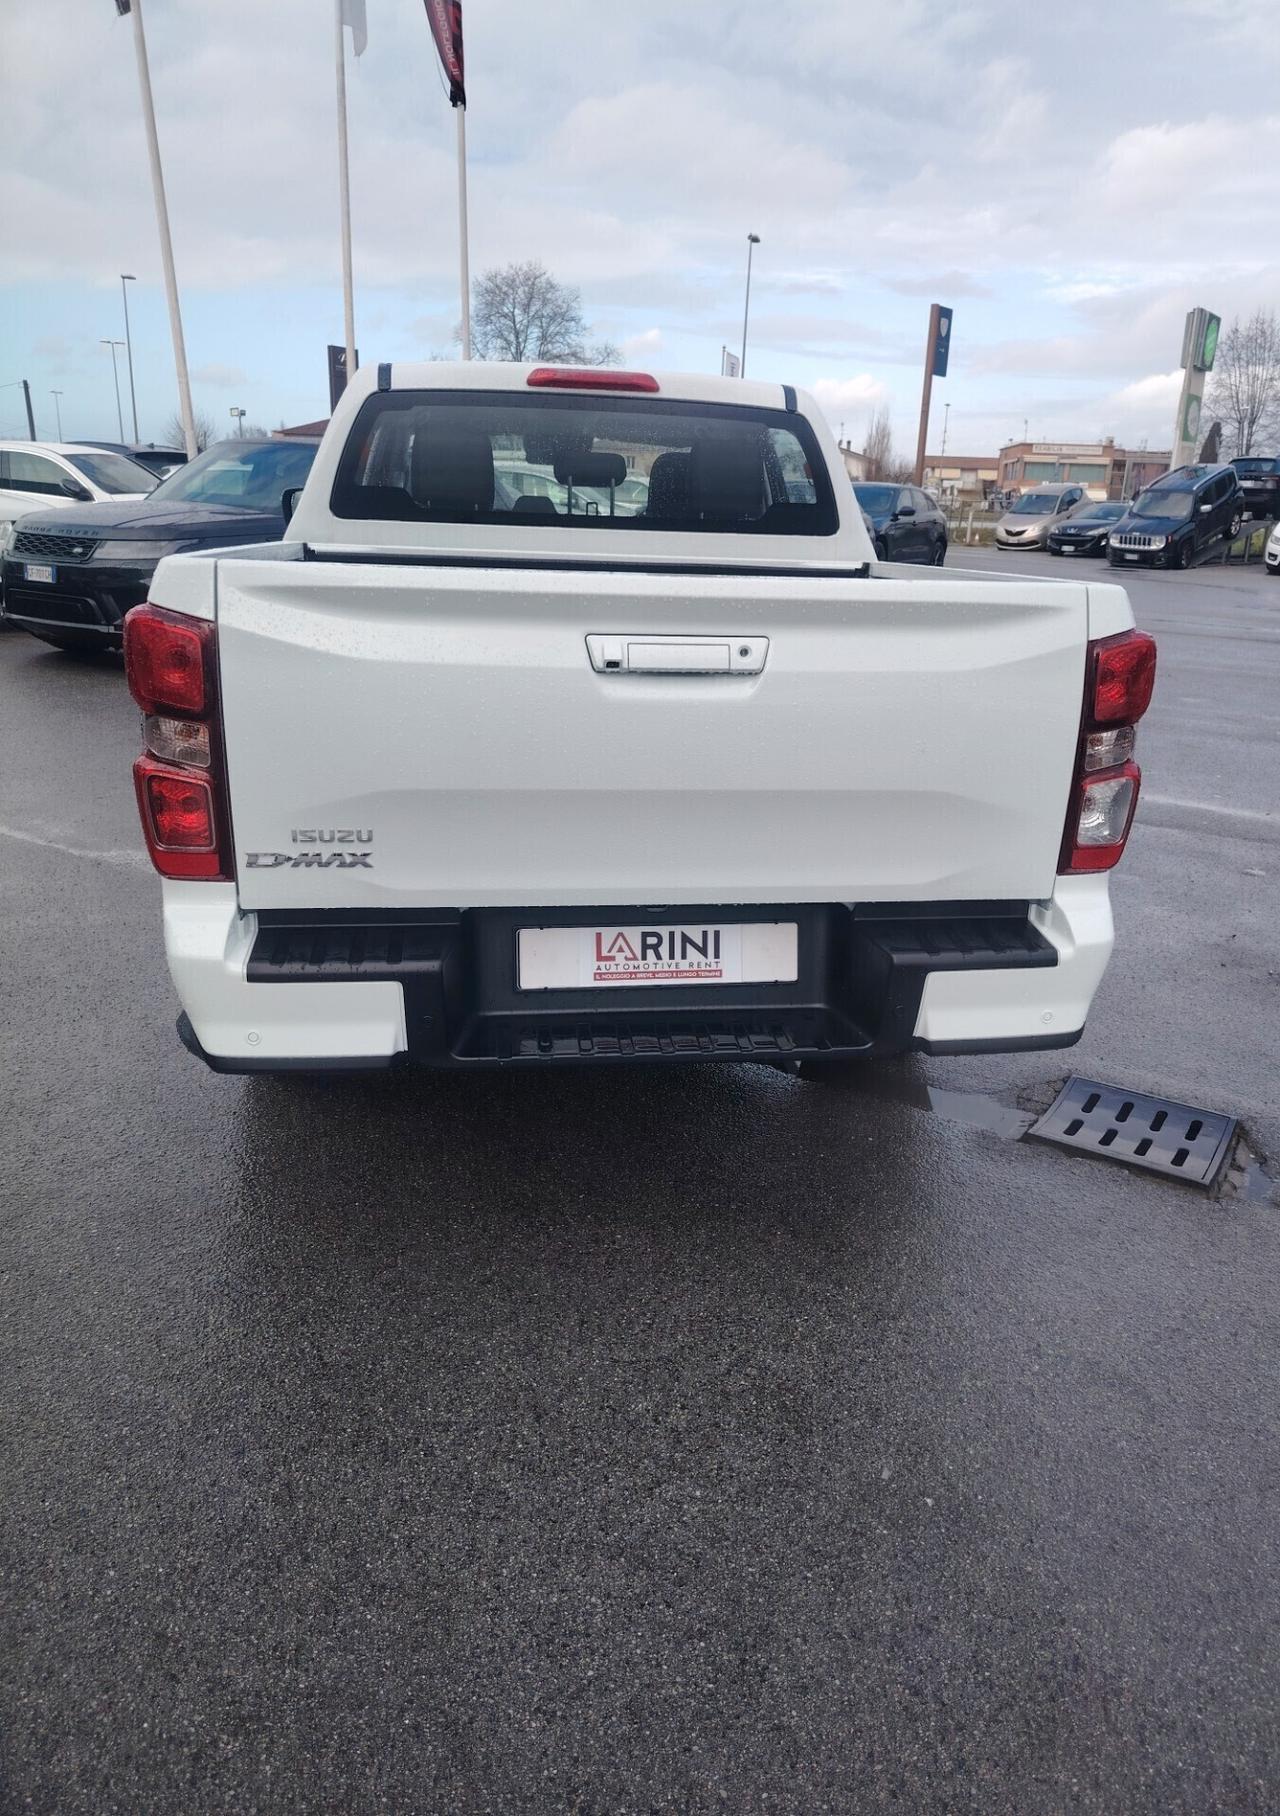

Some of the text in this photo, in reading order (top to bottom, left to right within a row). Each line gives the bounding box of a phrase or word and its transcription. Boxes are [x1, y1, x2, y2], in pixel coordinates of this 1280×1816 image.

[291, 829, 373, 843] ISUZU
[596, 930, 720, 961] LARINI
[596, 961, 721, 971] AUTOMOTIVE RENT
